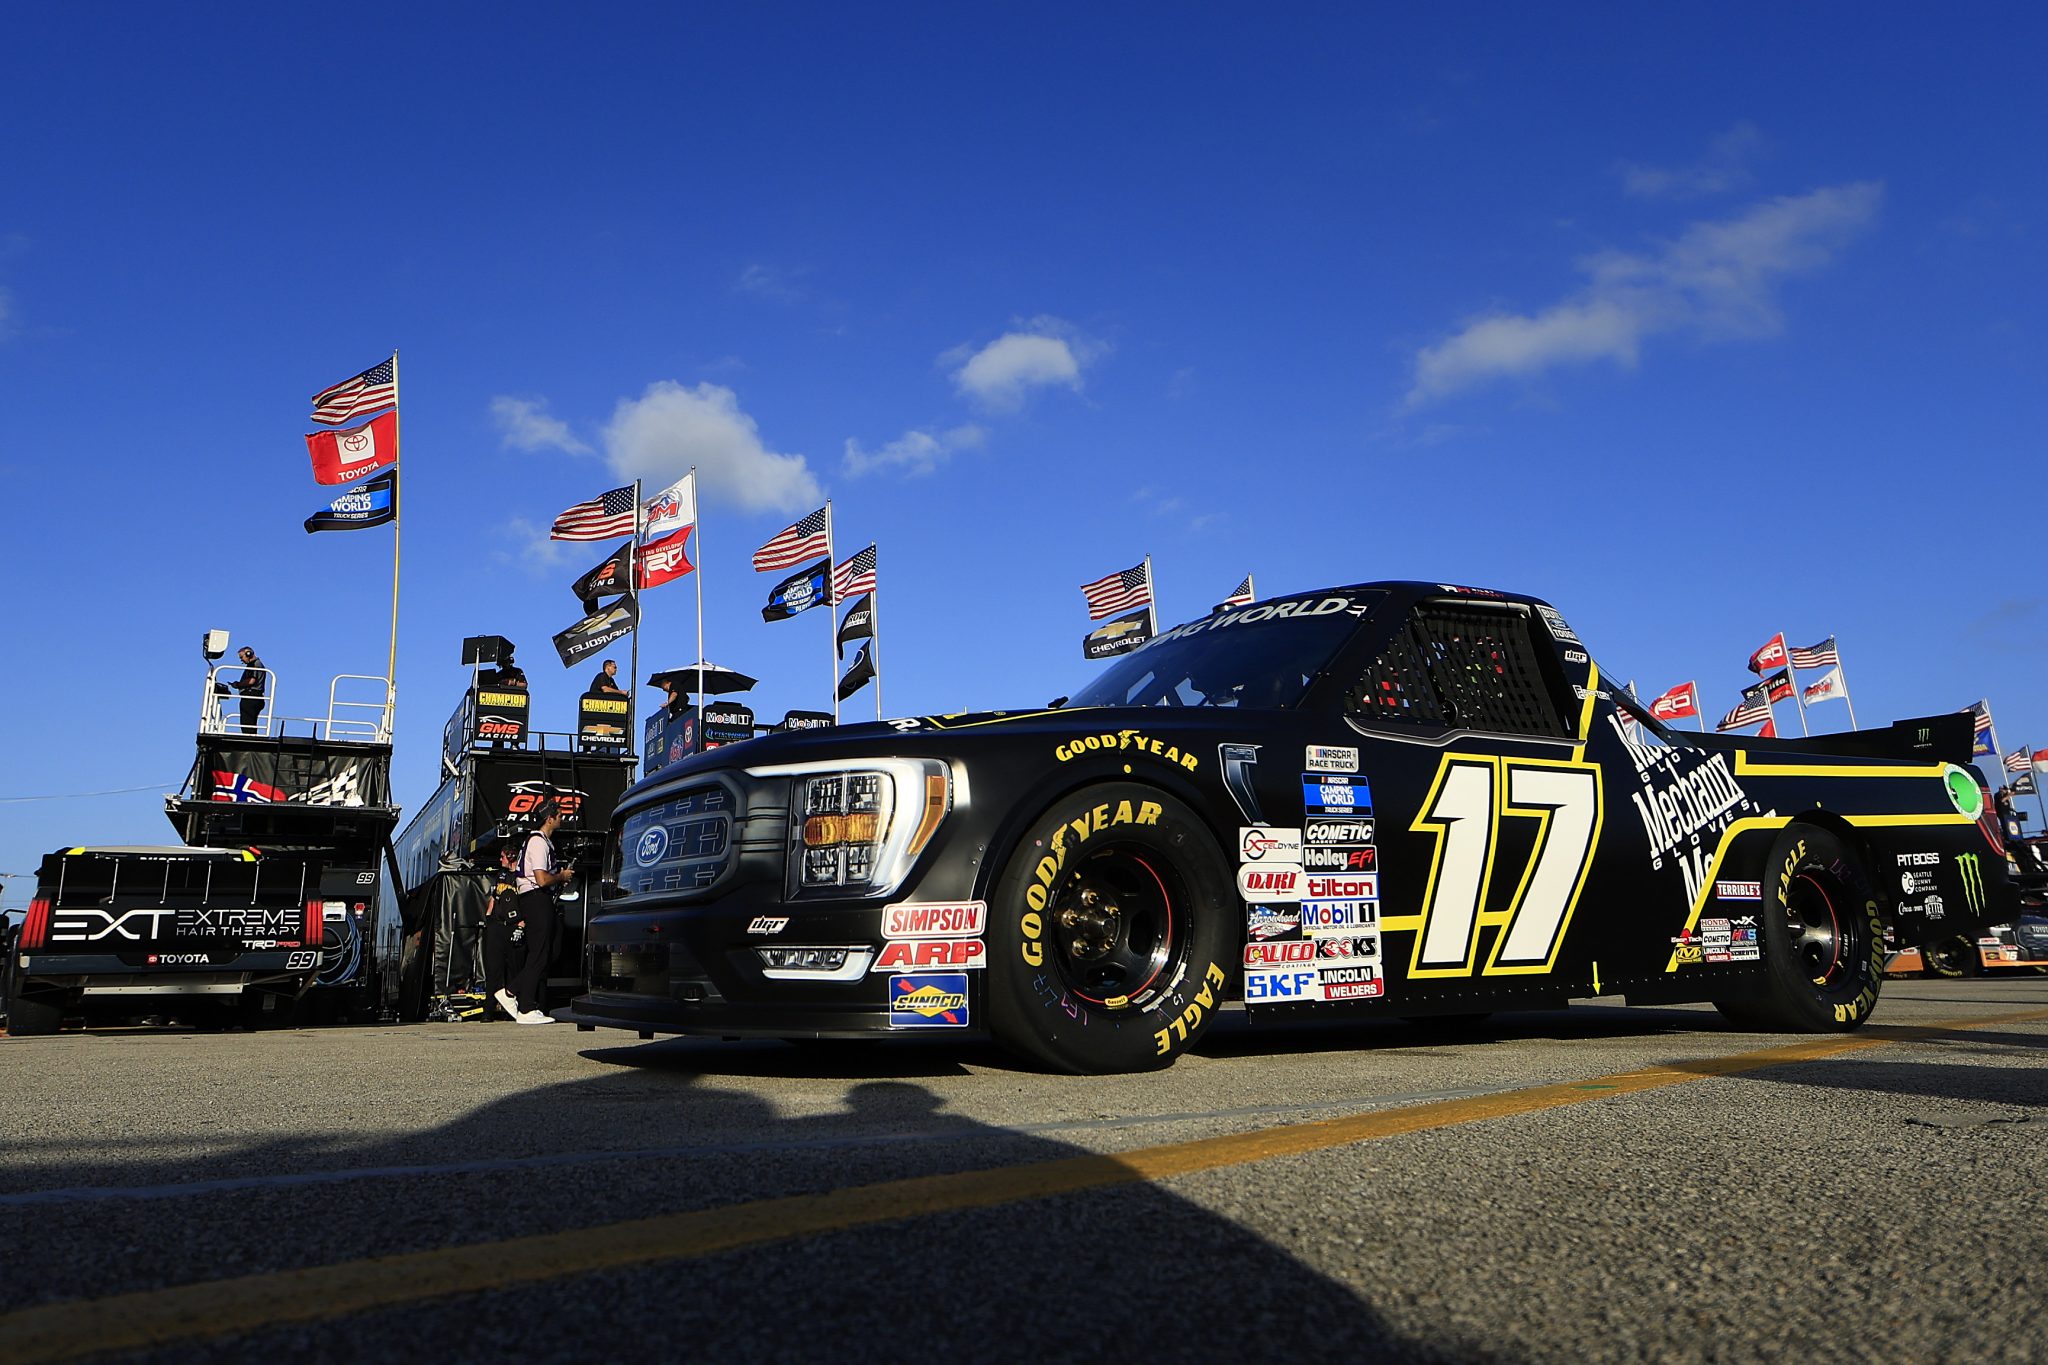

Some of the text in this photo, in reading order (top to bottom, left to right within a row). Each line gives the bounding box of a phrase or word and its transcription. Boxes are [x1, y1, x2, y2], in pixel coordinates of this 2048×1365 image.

[338, 461, 379, 481] TOYOTA
[335, 493, 371, 504] AMPING
[331, 501, 372, 512] WORLD
[783, 586, 813, 601] WORLD
[1209, 598, 1349, 631] WORLD
[1091, 635, 1147, 654] CHEVROLET
[479, 693, 526, 705] CHAMPION
[584, 700, 627, 711] CHAMPION
[706, 712, 738, 725] Mobil
[789, 717, 818, 729] Mobil
[480, 722, 519, 734] GMS
[581, 735, 626, 743] CHEVROLET
[1322, 750, 1352, 759] NASCAR
[1309, 760, 1329, 768] RACE
[1327, 776, 1349, 785] NASCAR
[1320, 785, 1354, 795] CAMPING
[1321, 794, 1355, 806] WORLD
[1632, 751, 1746, 860] Mechanix
[1306, 824, 1373, 841] COMETIC
[1305, 848, 1348, 871] Holley
[1416, 759, 1599, 969] 17
[1896, 852, 1940, 867] PIT BOSS
[356, 873, 375, 884] 99
[1913, 871, 1932, 879] SEATTLE
[1308, 879, 1375, 897] tilton
[1717, 884, 1760, 896] TERRIBLE'S
[1914, 885, 1938, 893] COMPANY
[177, 909, 300, 925] EXTREME
[890, 907, 979, 933] SIMPSON
[1303, 903, 1354, 926] Mobil
[52, 909, 176, 941] EXT
[176, 926, 300, 937] HAIR THERAPY
[1703, 935, 1730, 943] COMETIC
[877, 941, 984, 967] ARP
[1245, 943, 1315, 964] CALICO
[1316, 937, 1377, 958] KOOKS
[158, 953, 210, 965] TOYOTA
[285, 951, 317, 970] 99
[1318, 967, 1371, 985] LINCOLN
[1247, 973, 1315, 998] SKF
[1329, 984, 1377, 998] WELDERS
[896, 995, 961, 1008] SUNOCO
[1153, 962, 1225, 1056] EAGLE
